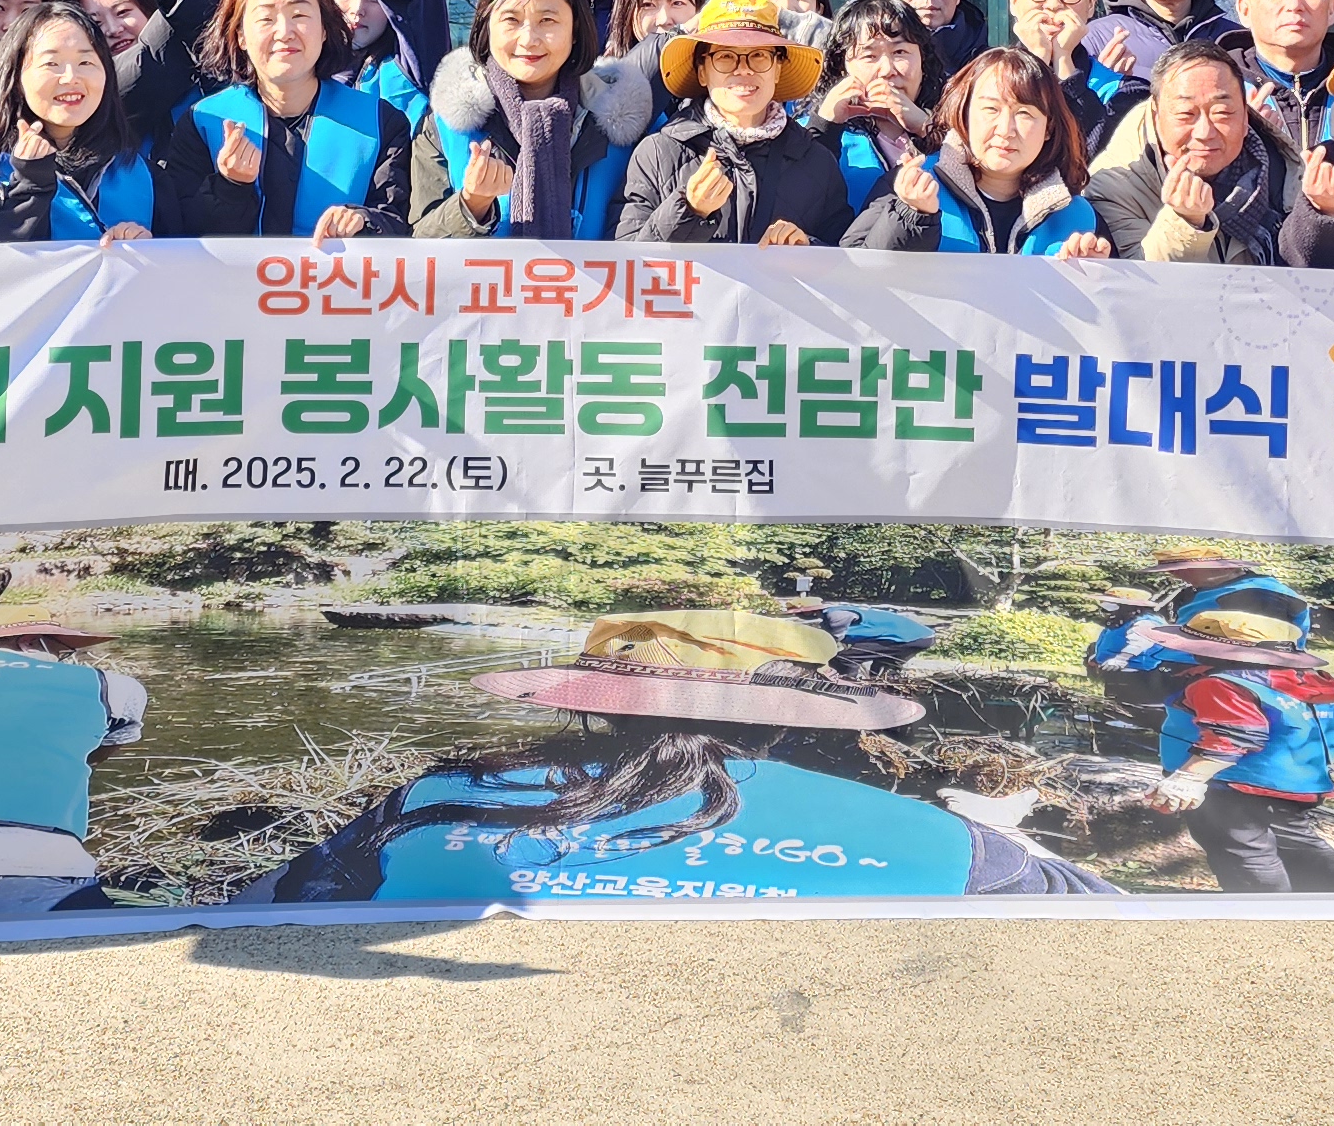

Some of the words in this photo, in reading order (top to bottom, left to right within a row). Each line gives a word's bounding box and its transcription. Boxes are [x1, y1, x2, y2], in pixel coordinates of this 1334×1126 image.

[255, 256, 437, 317] 양산시
[458, 258, 701, 320] 교육기관
[44, 337, 245, 439] 지원
[279, 337, 667, 438] 봉사활동
[701, 342, 983, 443] 전담반
[1014, 352, 1290, 460] 발대식
[164, 456, 209, 493] 때.
[221, 455, 327, 491] 2025.
[339, 455, 371, 491] 2.
[383, 454, 509, 493] 22.(토)
[582, 456, 626, 495] 곳.
[637, 457, 775, 496] 늘푸른집
